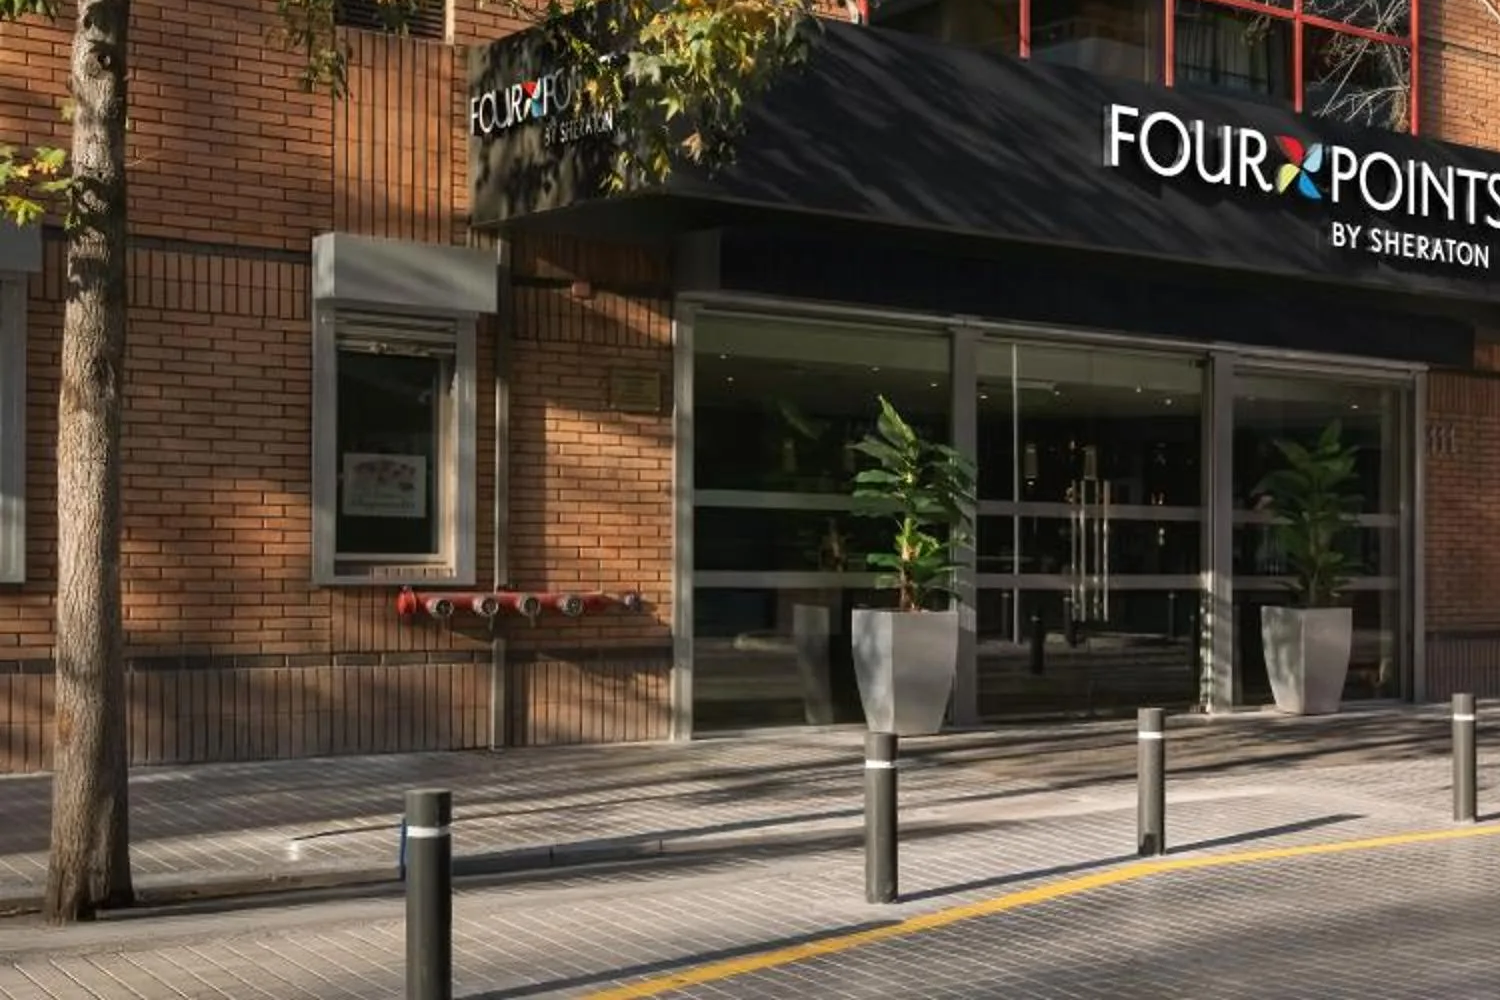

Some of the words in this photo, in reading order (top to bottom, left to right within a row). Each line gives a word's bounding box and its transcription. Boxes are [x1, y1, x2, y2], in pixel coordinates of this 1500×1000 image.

[471, 83, 523, 136] FOUR
[1110, 103, 1273, 192] FOUR
[1332, 221, 1361, 249] BY
[1370, 228, 1489, 269] SHERATON
